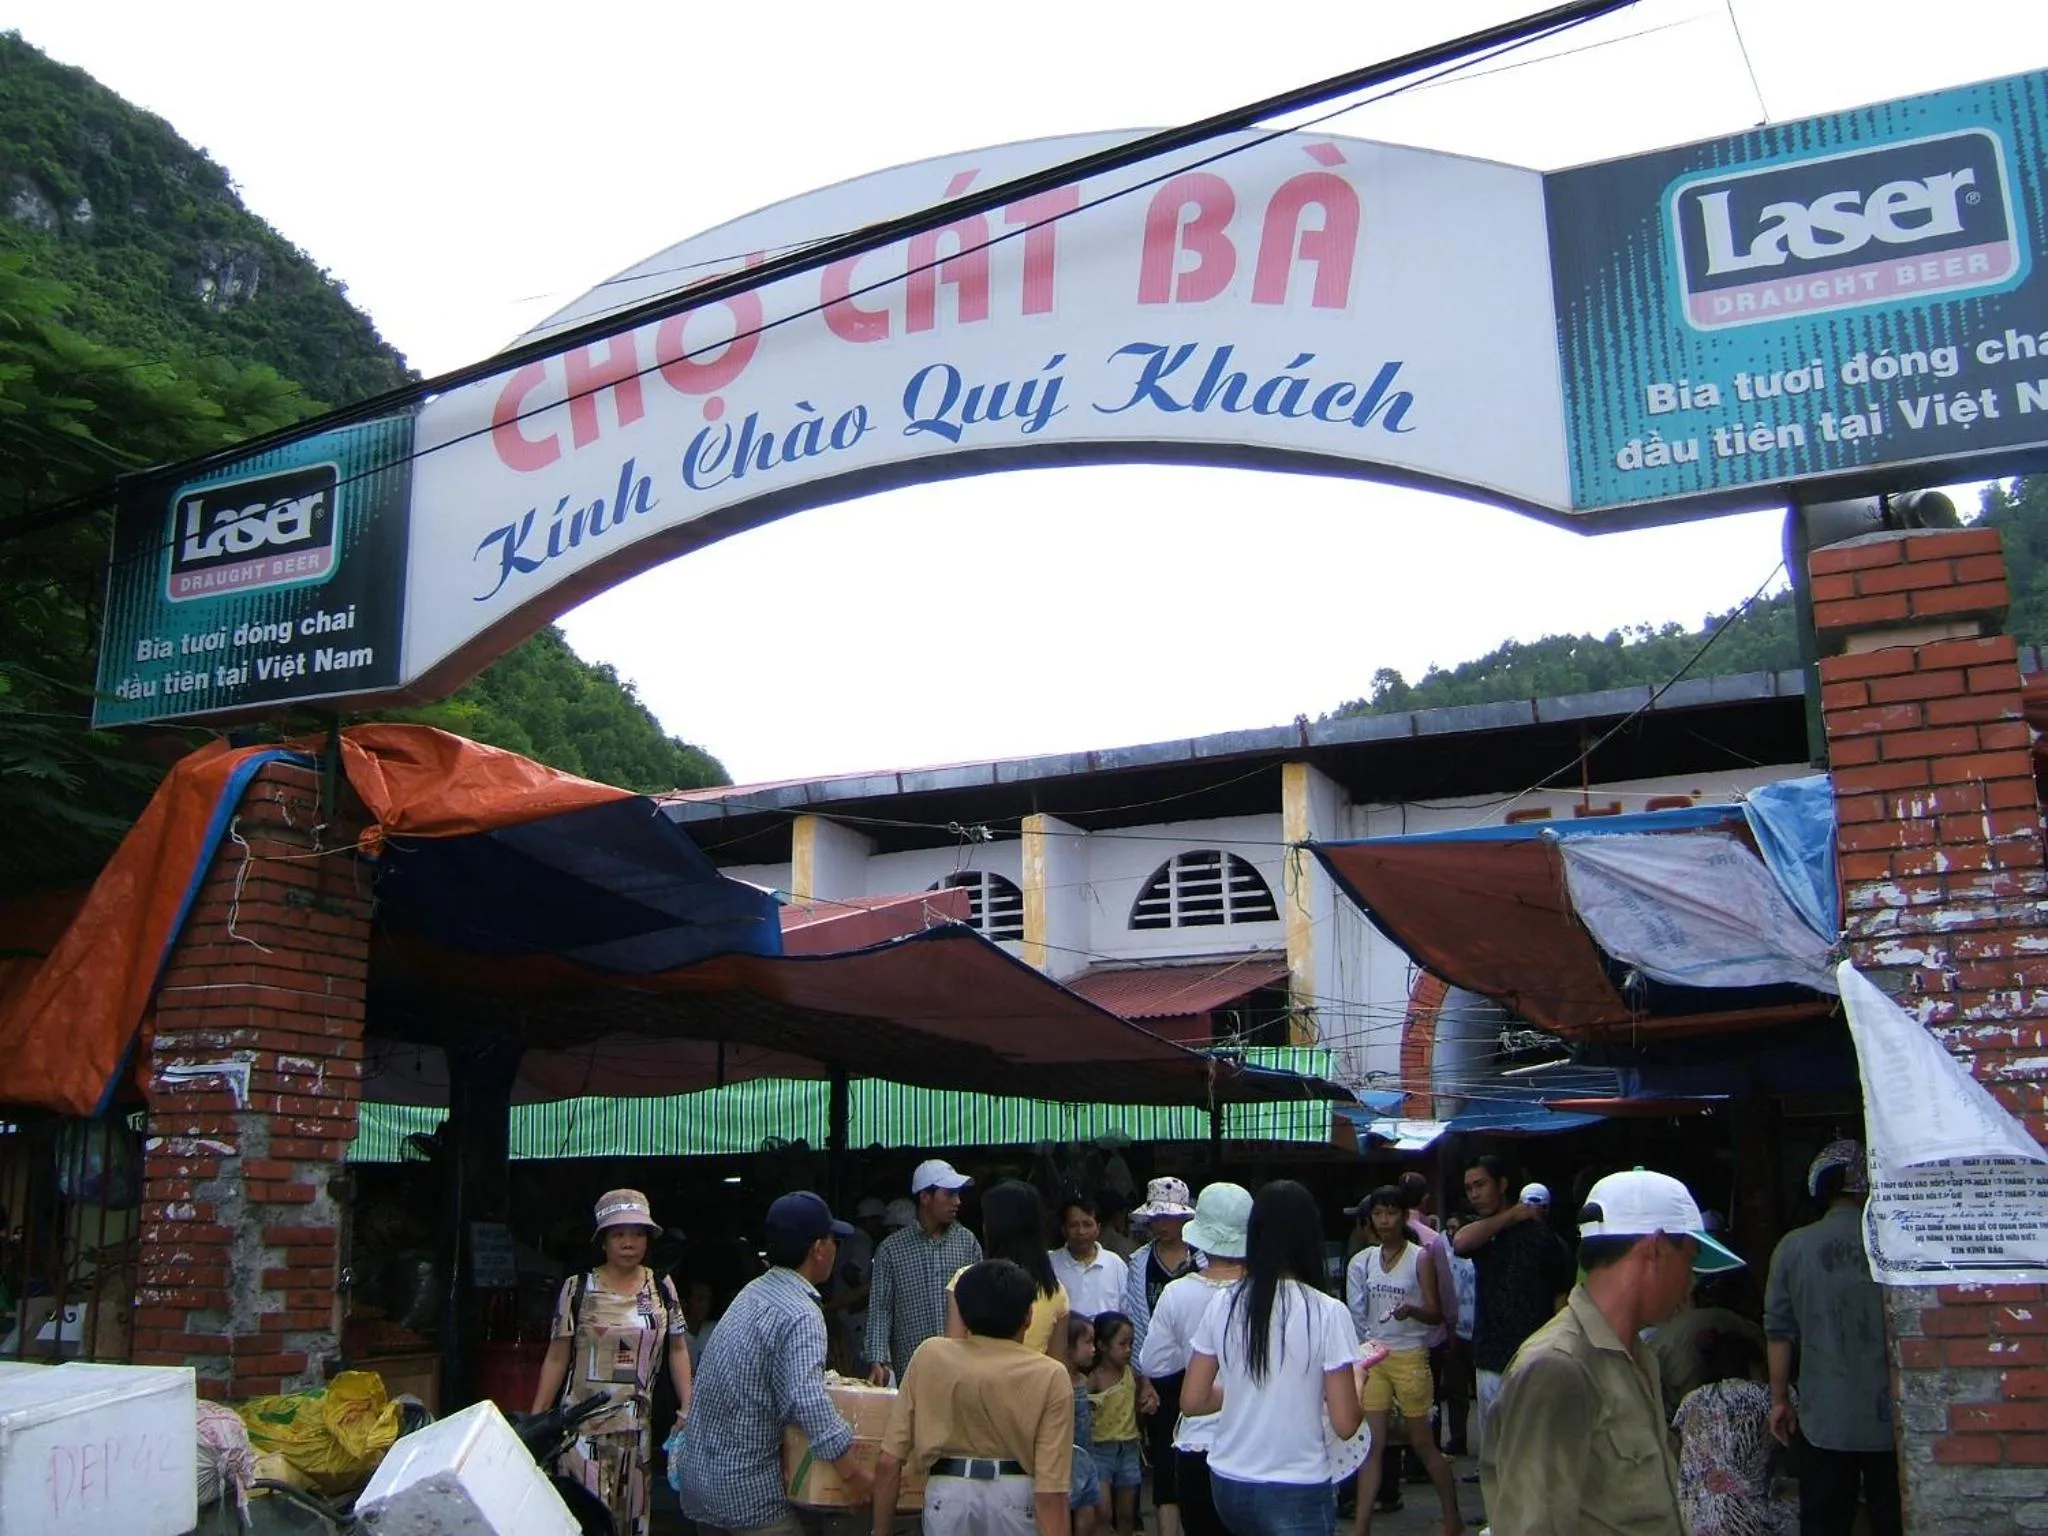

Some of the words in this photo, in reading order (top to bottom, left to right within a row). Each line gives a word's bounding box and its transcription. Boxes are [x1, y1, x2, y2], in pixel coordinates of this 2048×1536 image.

[1697, 167, 1976, 276] Laser
[491, 250, 766, 474] CHỢ
[819, 168, 1080, 343] CÁT
[1136, 142, 1363, 309] BÀ
[1713, 270, 1880, 319] DRAUGHT
[1898, 251, 1991, 285] BEER
[1646, 379, 1720, 415] Bia
[1734, 359, 1825, 401] tươi
[1841, 344, 1958, 385] đóng
[1616, 427, 1699, 471] đầu
[1713, 422, 1805, 458] tiên
[1818, 403, 1884, 446] tại
[1898, 387, 2000, 430] Việt
[2016, 379, 2048, 414] N
[473, 456, 660, 602] Kính
[682, 400, 877, 490] Chào
[903, 353, 1069, 444] Quý
[1091, 342, 1416, 433] Khách
[181, 492, 324, 561] Laser
[181, 563, 265, 592] DRAUGHT
[272, 554, 320, 576] BEER
[136, 638, 173, 662] Bia
[181, 626, 225, 652] tươi
[233, 620, 292, 645] đóng
[301, 605, 355, 635] chai
[163, 671, 208, 696] tiên
[257, 655, 305, 682] Việt
[314, 646, 373, 673] Nam
